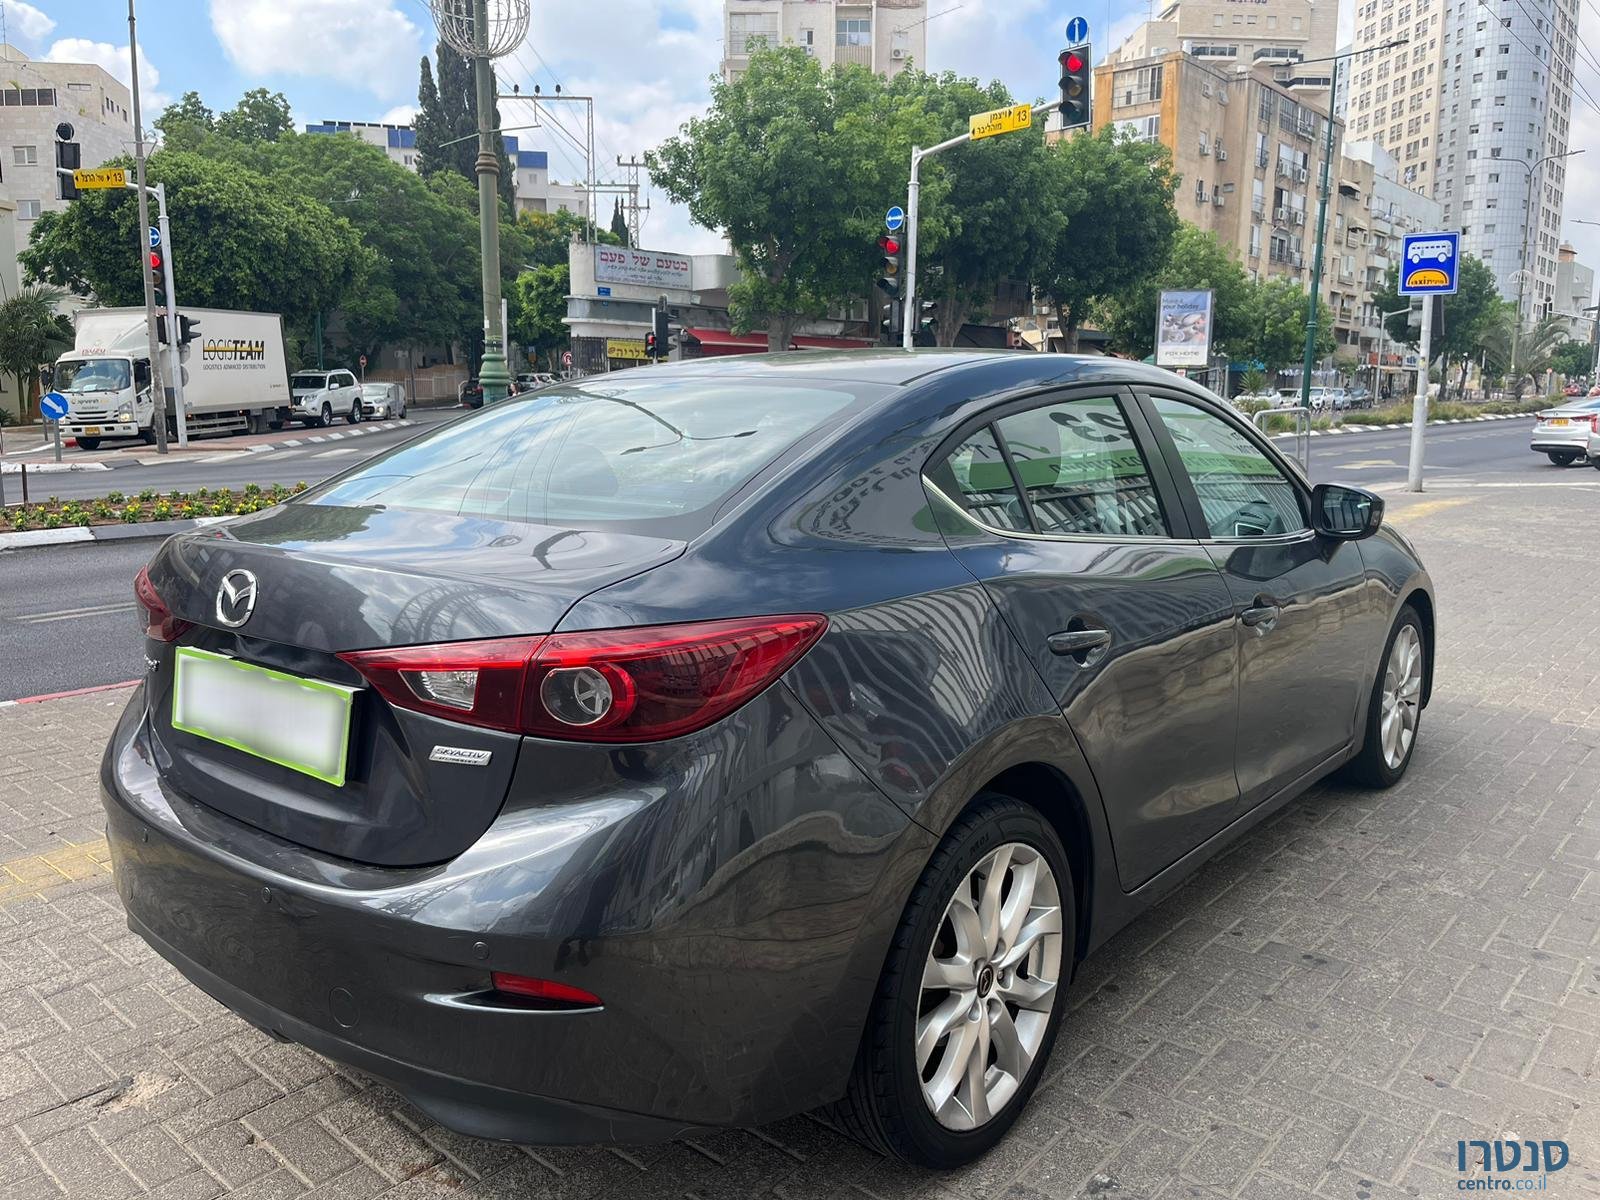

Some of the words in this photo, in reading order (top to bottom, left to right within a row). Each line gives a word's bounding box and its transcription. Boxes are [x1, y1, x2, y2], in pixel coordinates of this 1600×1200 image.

[1017, 110, 1027, 122] 13
[113, 173, 123, 182] 13
[600, 252, 625, 264] פעם
[631, 252, 650, 266] של
[656, 258, 688, 271] בטעם
[202, 339, 265, 361] LOGISTEAM
[435, 747, 486, 758] SKYACTIV
